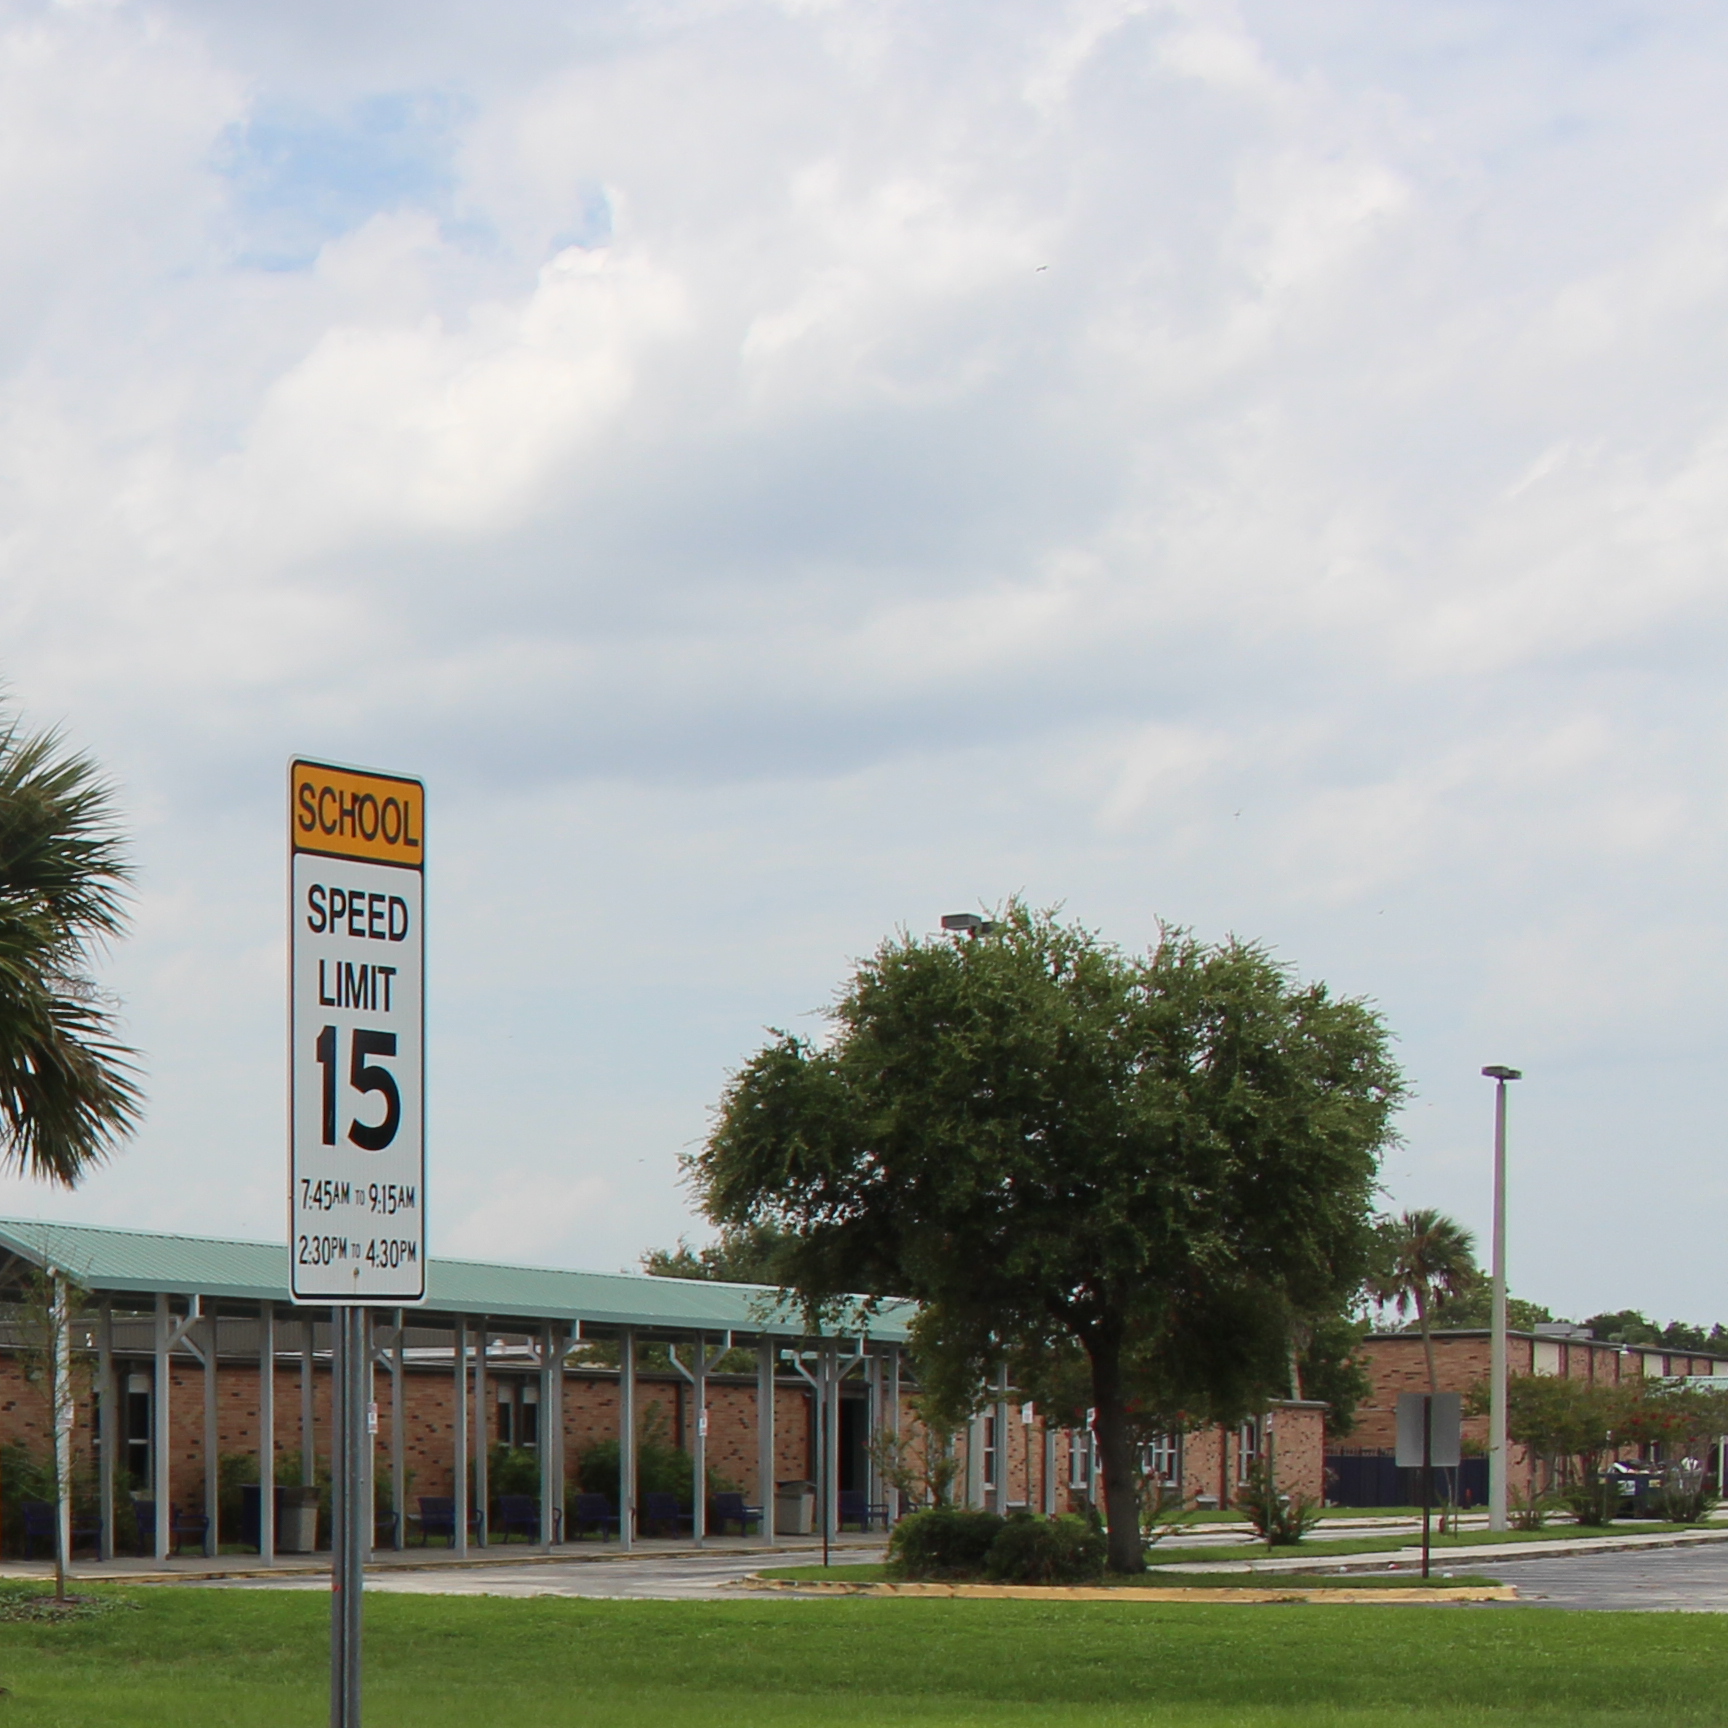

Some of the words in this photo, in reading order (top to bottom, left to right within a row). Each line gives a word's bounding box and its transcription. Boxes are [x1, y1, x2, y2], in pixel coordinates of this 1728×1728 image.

[298, 782, 419, 847] SCHOOL
[307, 884, 409, 942] SPEED
[318, 959, 396, 1012] LIMIT
[316, 1024, 401, 1151] 15
[301, 1178, 350, 1211] 7:45AM
[355, 1189, 365, 1205] TO
[369, 1183, 415, 1215] 9:15AM
[299, 1234, 348, 1266] 2:30PM
[351, 1243, 361, 1259] TO
[365, 1238, 417, 1269] 4:30PM
